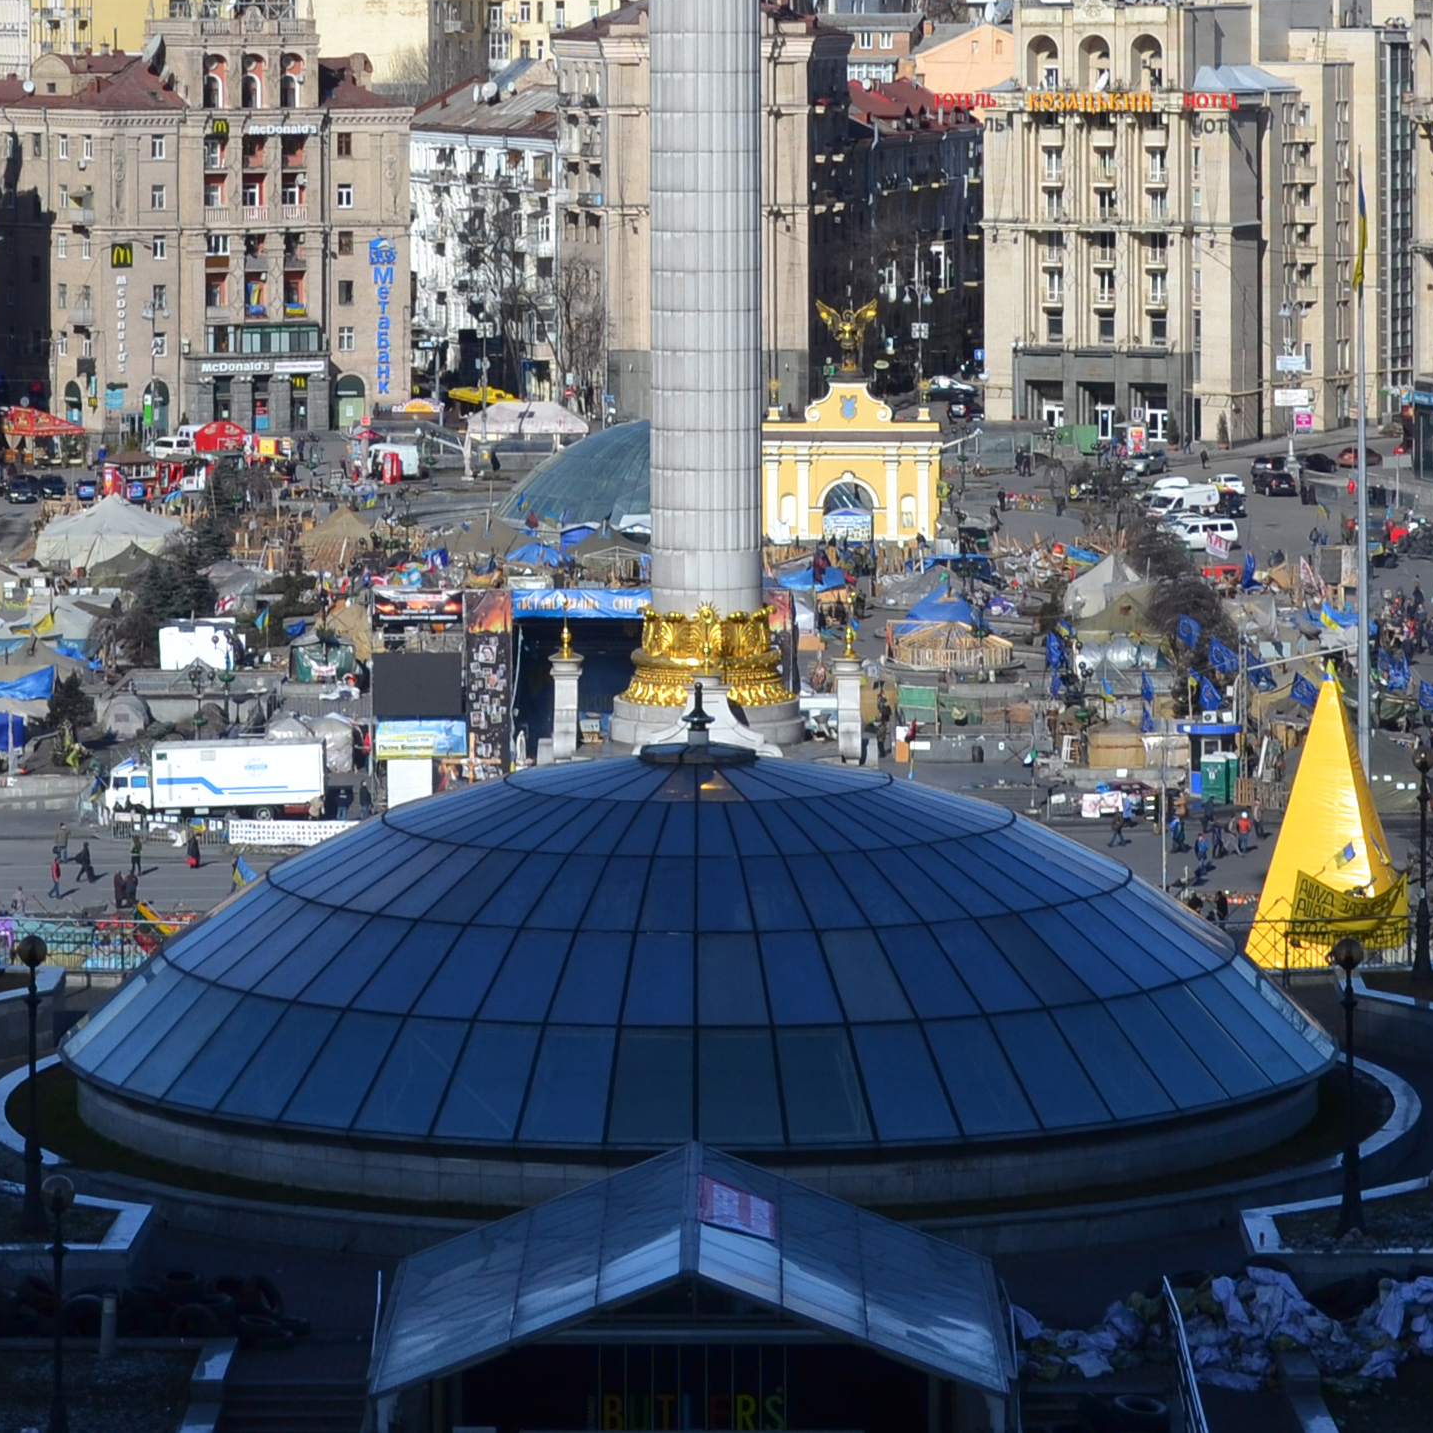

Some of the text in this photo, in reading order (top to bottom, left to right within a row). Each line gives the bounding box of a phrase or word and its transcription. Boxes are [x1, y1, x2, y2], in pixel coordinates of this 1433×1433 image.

[933, 91, 1153, 115] ГОТЕЛЬ КОЗАЦЬКИЙ
[1183, 92, 1241, 110] HOTEL
[248, 124, 318, 136] McDonald's
[116, 275, 128, 374] McDonald's
[373, 266, 394, 395] МетаБанк
[201, 361, 271, 373] McDonald's
[602, 1393, 785, 1432] BUTLERS
